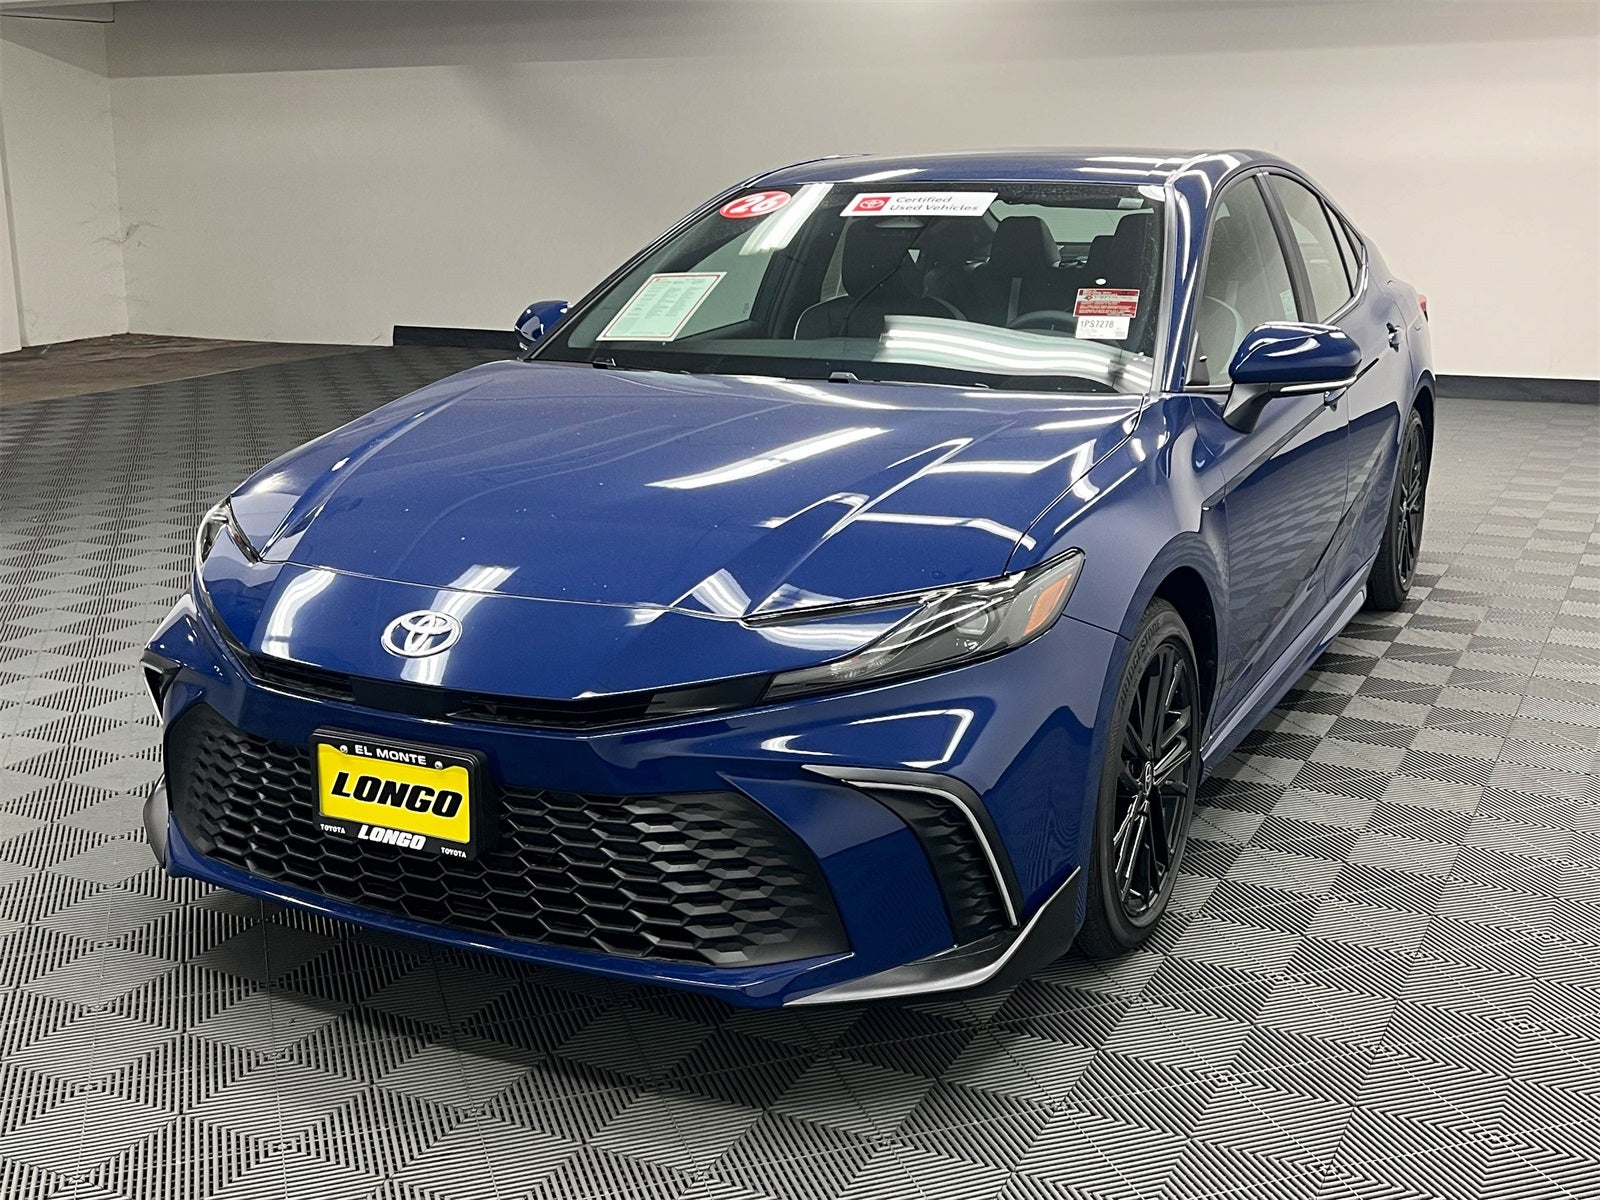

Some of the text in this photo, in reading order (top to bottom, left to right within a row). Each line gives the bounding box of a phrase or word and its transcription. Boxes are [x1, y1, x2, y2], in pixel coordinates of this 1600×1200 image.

[1080, 320, 1114, 328] 1PS7278
[354, 744, 427, 765] EL MONTE
[331, 771, 463, 818] LONGO
[320, 823, 467, 859] TOYOTA LONGO TOYOTA
